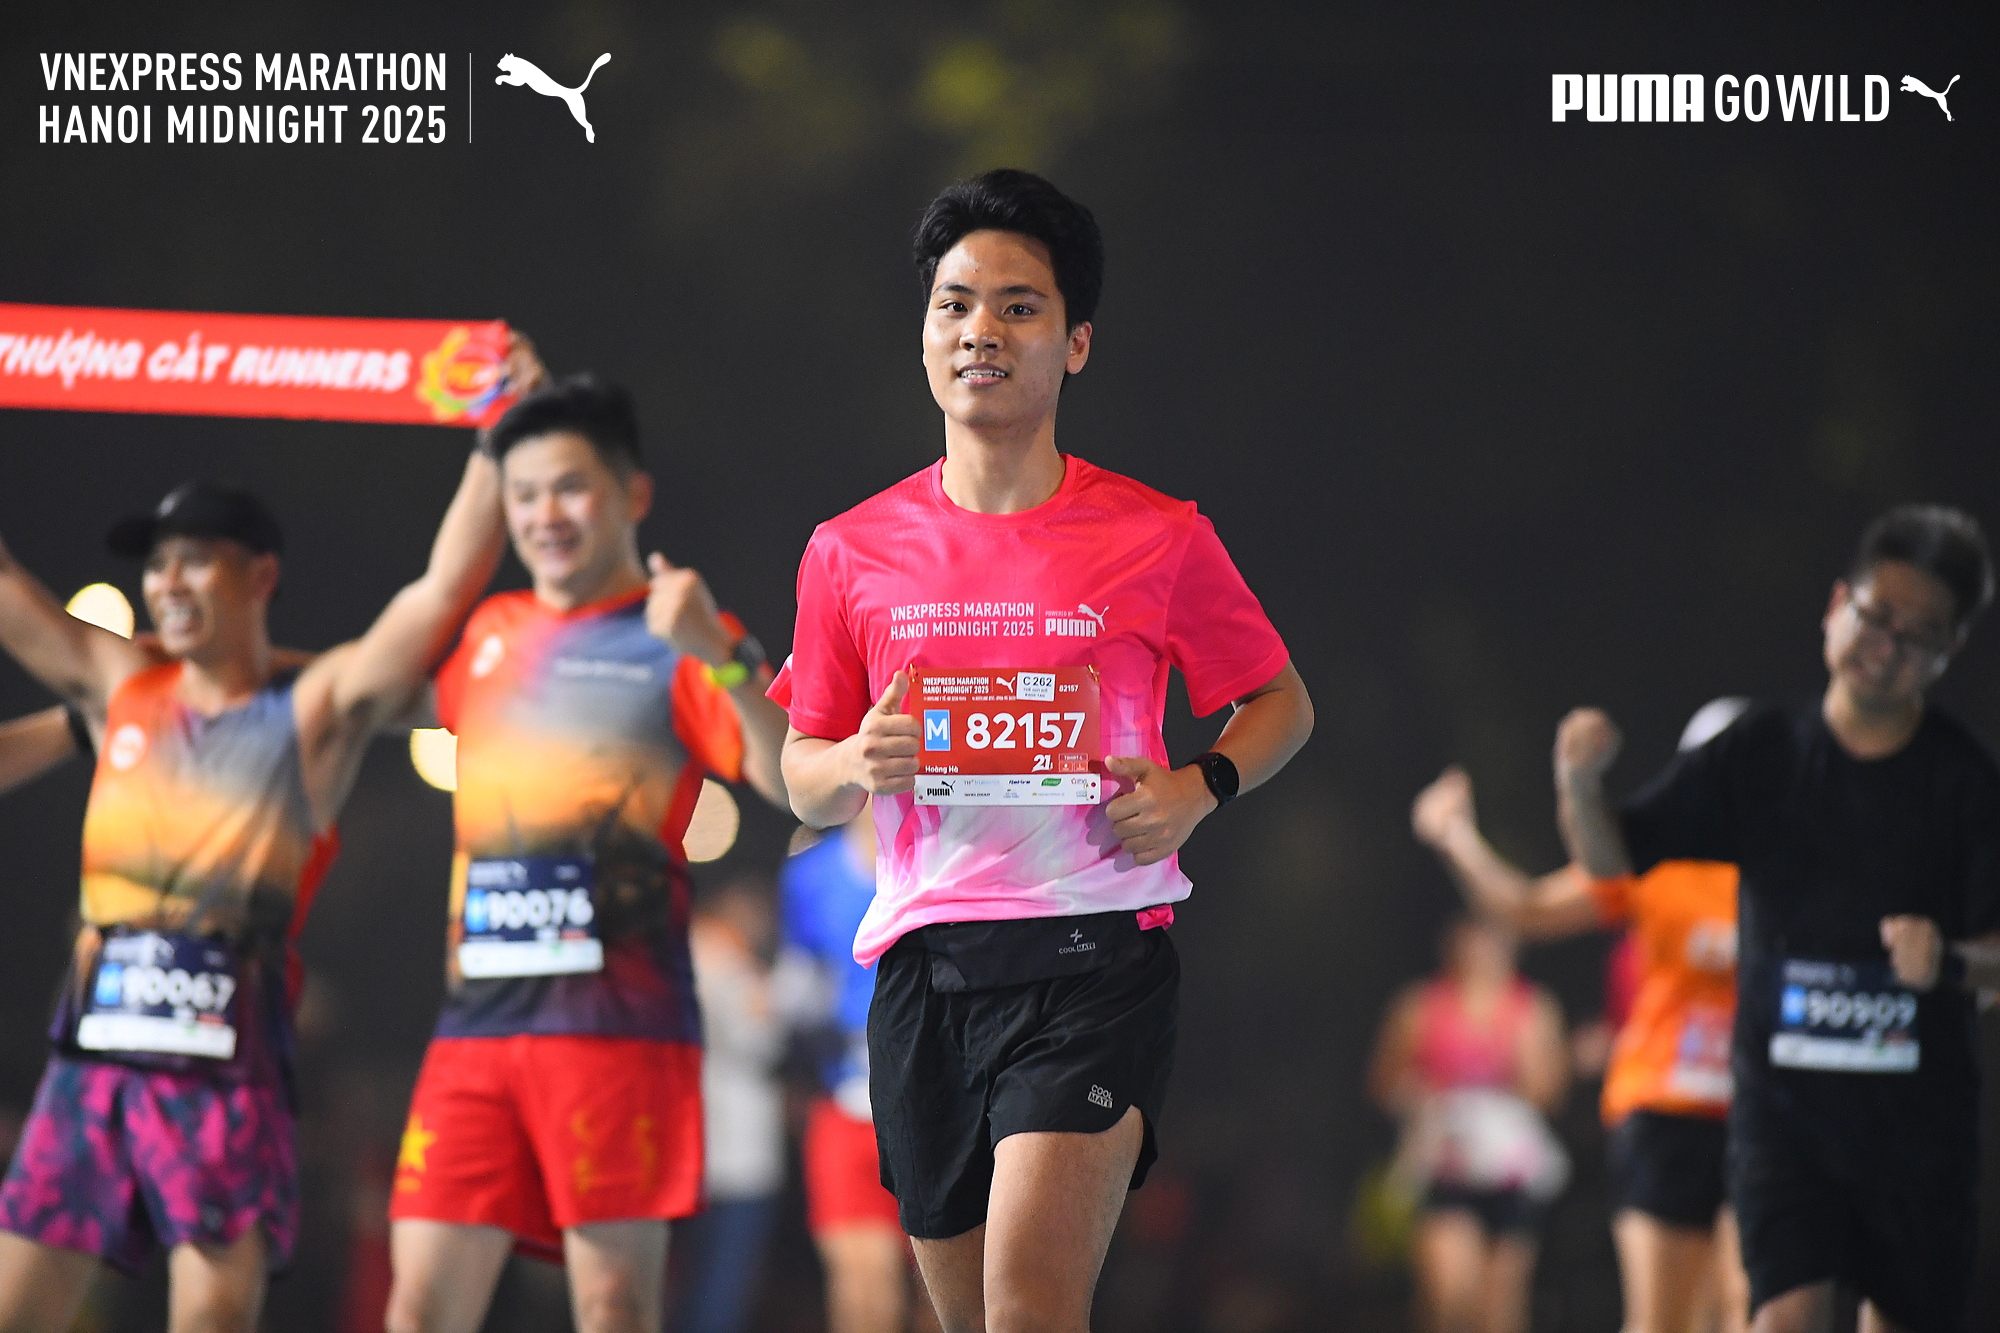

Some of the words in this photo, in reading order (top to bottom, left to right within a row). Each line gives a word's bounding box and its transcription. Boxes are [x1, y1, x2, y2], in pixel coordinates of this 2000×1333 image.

[229, 346, 412, 392] RUNNERS
[890, 602, 960, 621] VNEXPRESS
[963, 602, 1034, 617] MARATHON
[890, 622, 928, 640] HANOI
[932, 620, 998, 637] MIDNIGHT
[1003, 620, 1034, 637] 2025
[1045, 618, 1097, 637] PUMA
[922, 677, 956, 685] VNEXPRESS
[956, 677, 989, 685] MARATHON
[922, 685, 942, 694] HANOI
[942, 685, 973, 694] MIDNIGHT
[973, 685, 989, 694] 2025
[1023, 676, 1031, 686] C
[1032, 677, 1052, 687] 262
[926, 718, 948, 741] M
[965, 712, 1086, 749] 82157
[1031, 754, 1054, 772] 21
[926, 788, 950, 797] PUMA
[488, 887, 595, 931] 90076
[122, 965, 237, 1013] 90067
[1805, 989, 1918, 1030] 90909
[1091, 1084, 1113, 1101] COOL
